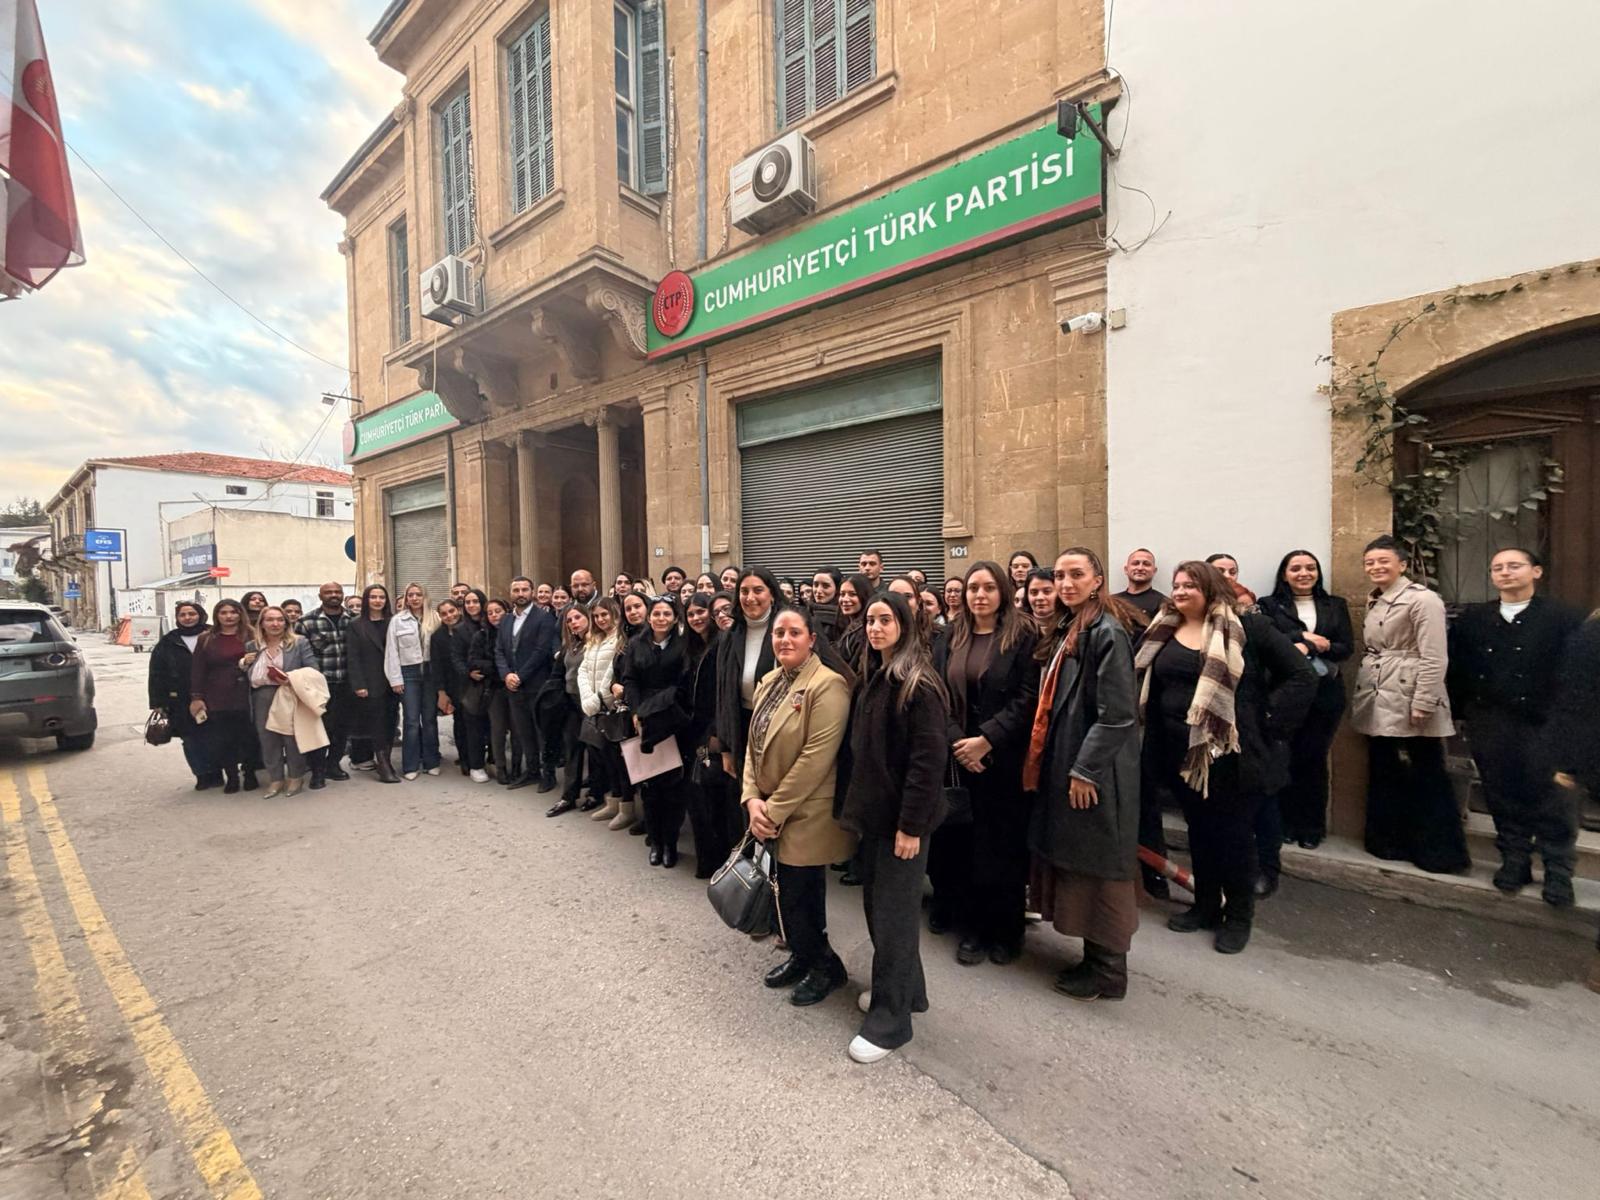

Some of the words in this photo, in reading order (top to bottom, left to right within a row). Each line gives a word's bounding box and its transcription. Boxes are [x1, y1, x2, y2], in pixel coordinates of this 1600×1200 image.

[704, 227, 857, 313] CUMHURİYETÇİ
[863, 202, 937, 252] TÜRK
[945, 138, 1074, 223] PARTİSİ
[664, 291, 682, 310] CTP
[359, 414, 405, 445] CUMHURİYETÇİ
[405, 409, 424, 429] TÜRK
[950, 546, 968, 557] 101
